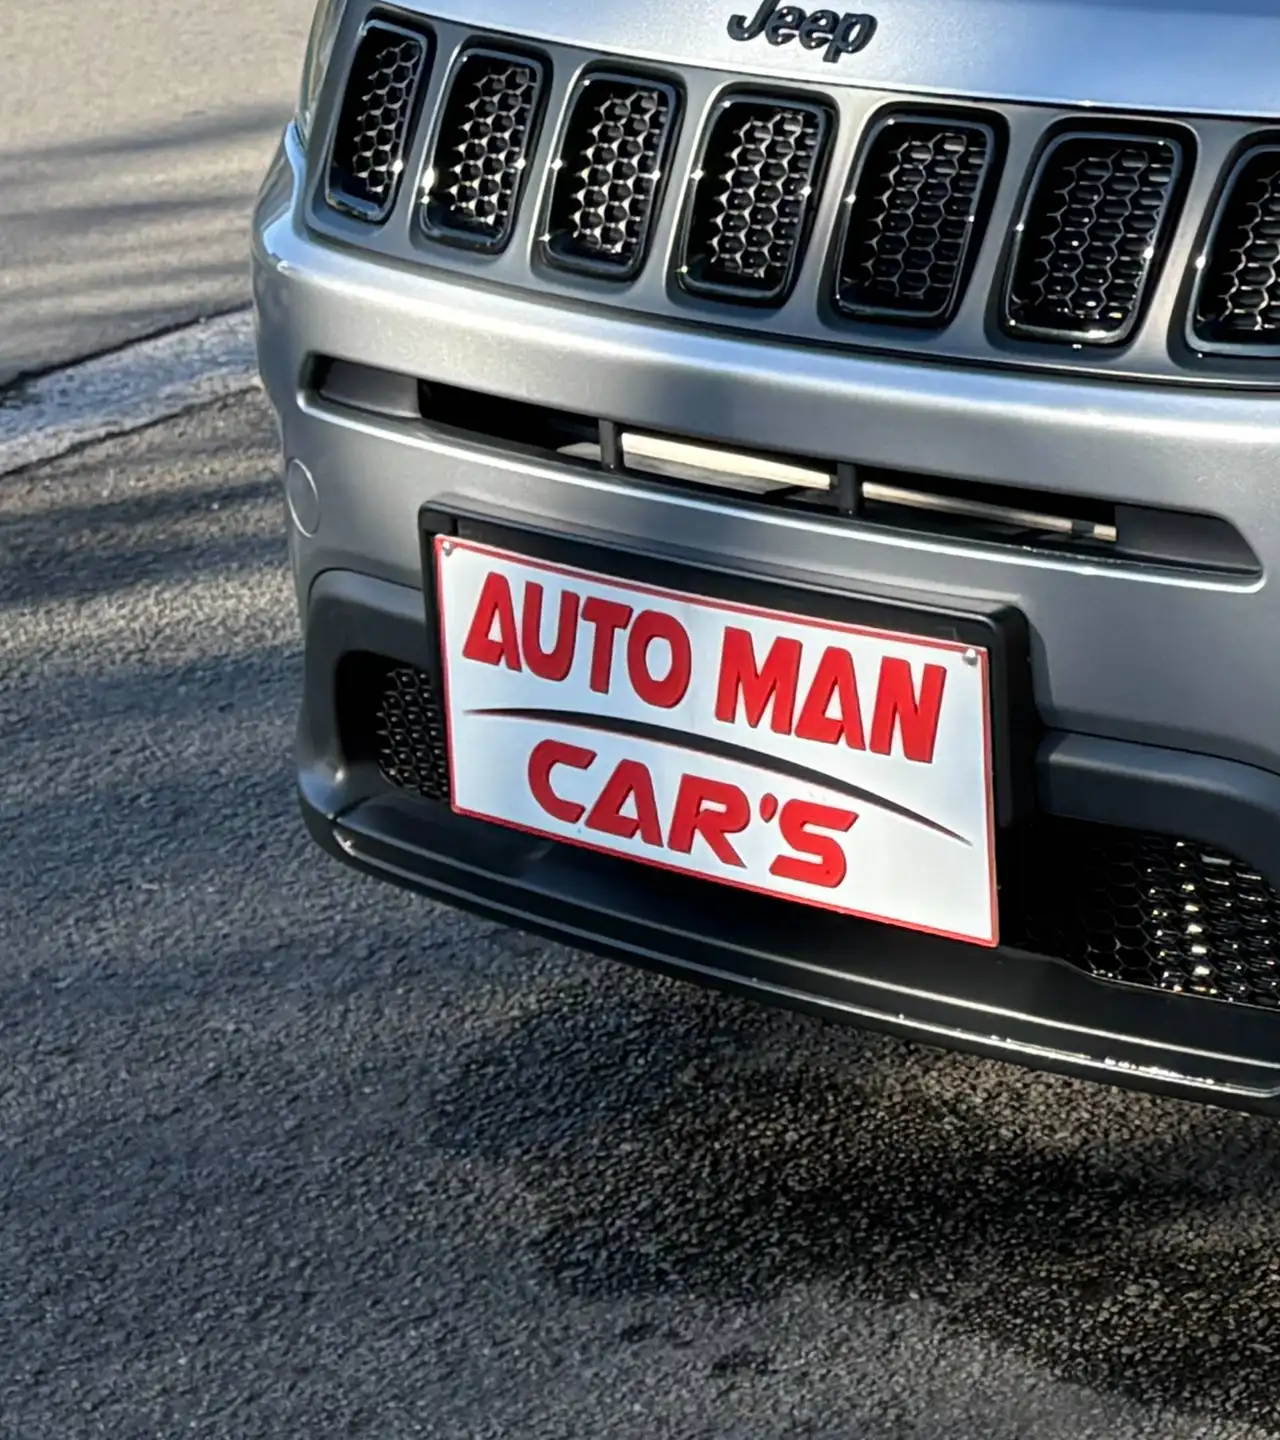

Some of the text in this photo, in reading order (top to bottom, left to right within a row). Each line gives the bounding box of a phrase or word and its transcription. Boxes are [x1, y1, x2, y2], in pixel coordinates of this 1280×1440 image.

[462, 571, 948, 764] AUTO MAN
[527, 738, 859, 889] CAR'S
